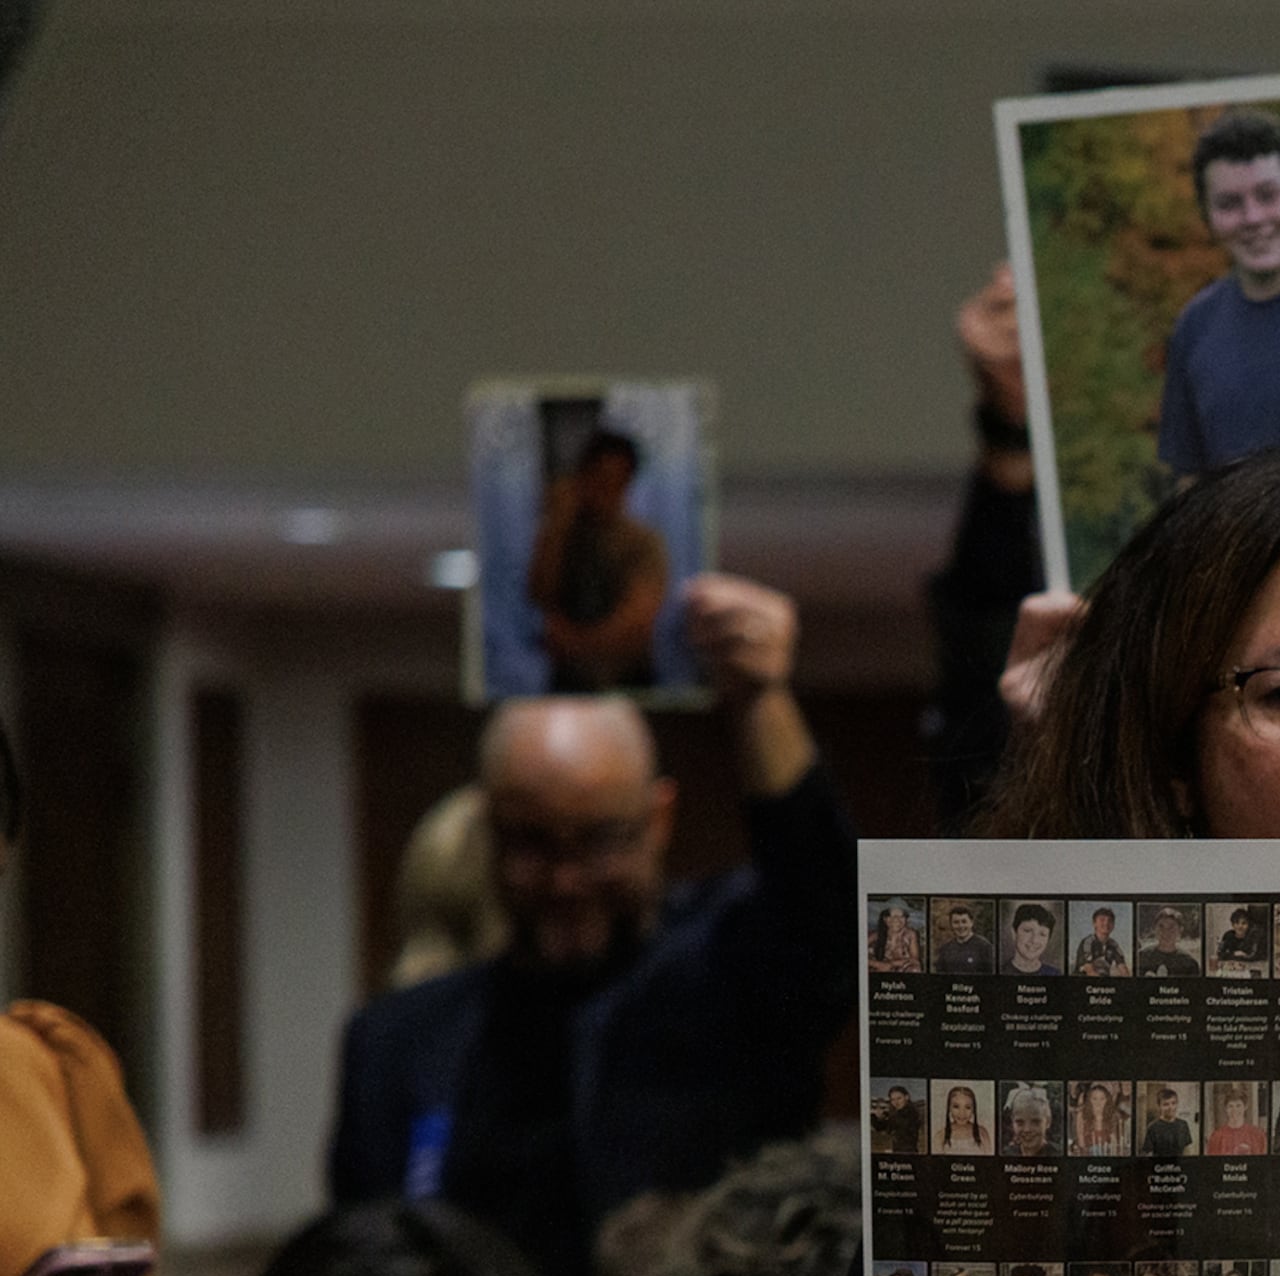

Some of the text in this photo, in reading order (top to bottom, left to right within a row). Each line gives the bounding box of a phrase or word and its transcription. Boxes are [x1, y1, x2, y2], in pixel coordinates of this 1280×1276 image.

[952, 984, 973, 994] Riley
[1086, 986, 1115, 994] Carson
[873, 992, 914, 1001] Anderson
[1017, 996, 1047, 1005] Bogard
[1089, 996, 1111, 1005] Bride
[1149, 996, 1189, 1005] Bronstein
[951, 1163, 975, 1172] Olivia
[1004, 1164, 1035, 1174] Mallory
[1087, 1164, 1111, 1173] Grace
[1224, 1163, 1247, 1172] David
